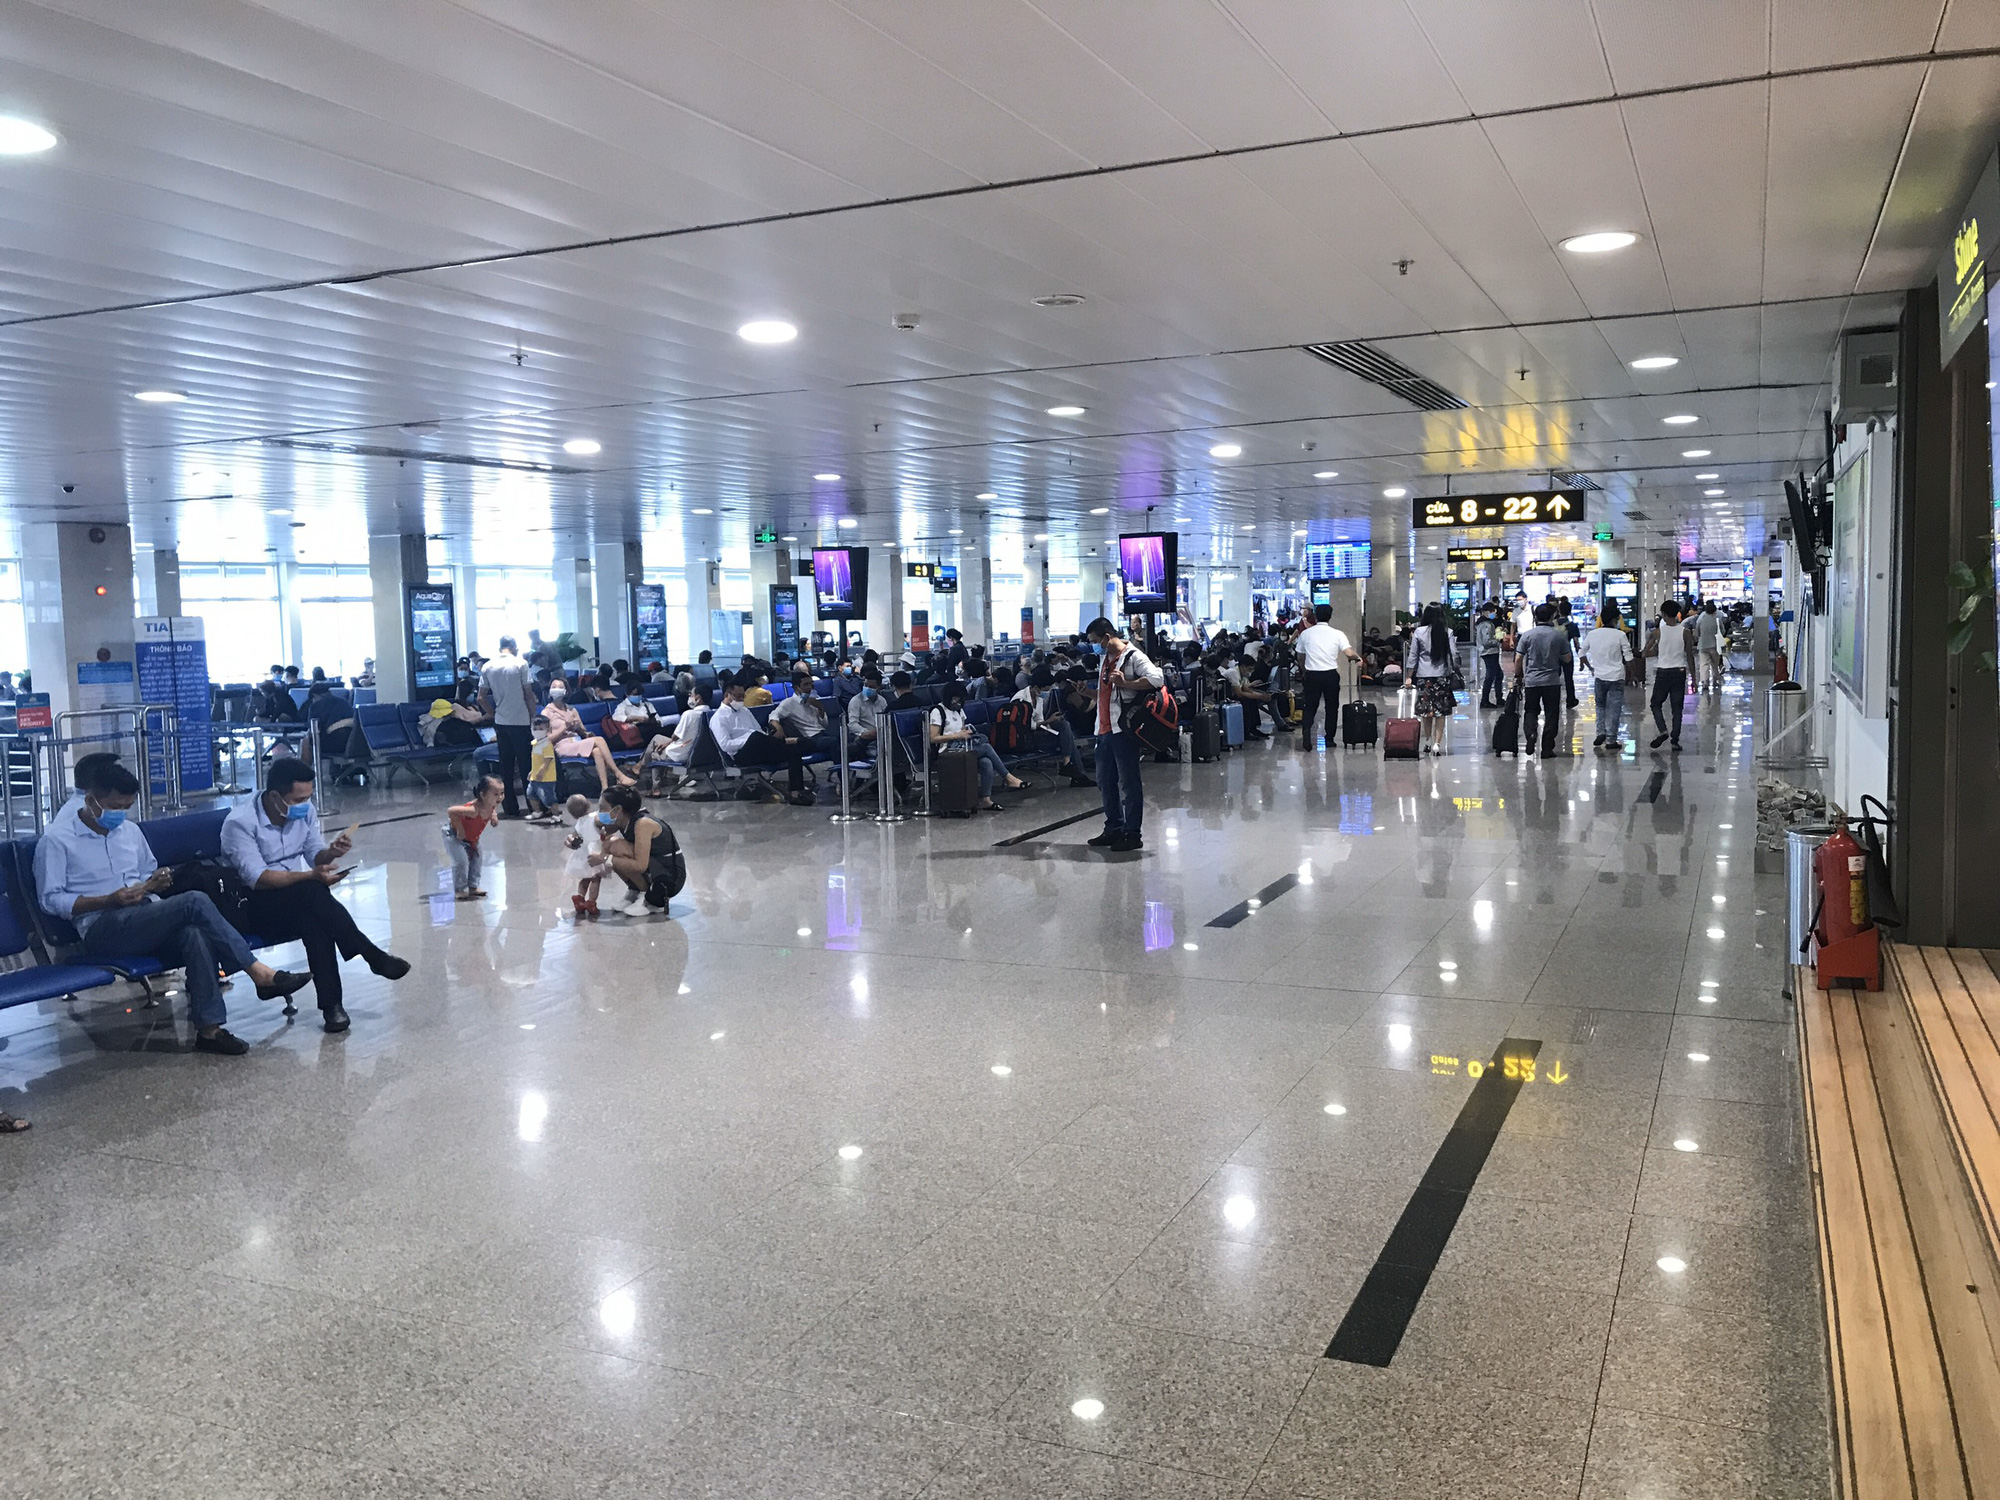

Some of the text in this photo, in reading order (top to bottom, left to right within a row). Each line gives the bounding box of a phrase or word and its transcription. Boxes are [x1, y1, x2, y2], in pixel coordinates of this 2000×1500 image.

[1461, 500, 1478, 522] 8
[1503, 497, 1537, 521] 22
[144, 622, 169, 632] TIA
